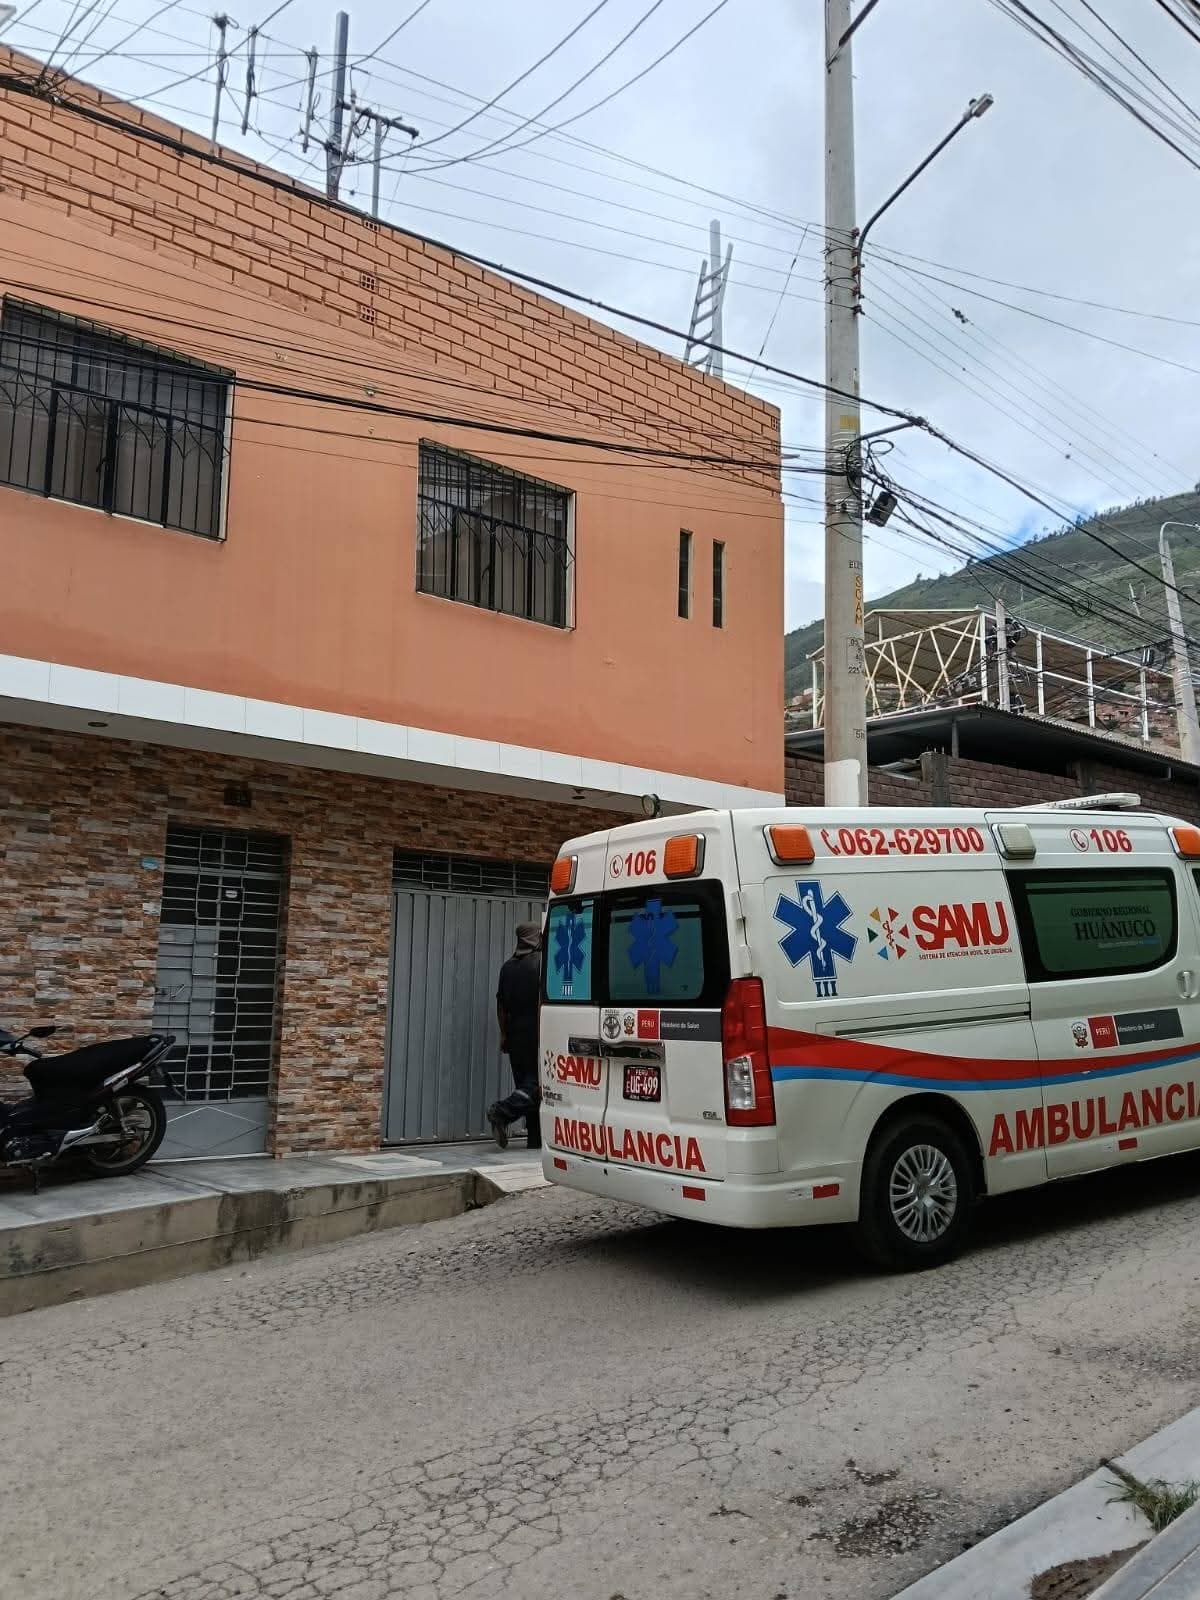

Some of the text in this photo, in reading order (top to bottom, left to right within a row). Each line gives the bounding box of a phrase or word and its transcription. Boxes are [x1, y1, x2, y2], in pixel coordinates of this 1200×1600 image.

[839, 827, 984, 855] 062-629700
[1090, 828, 1132, 853] 106
[625, 850, 656, 877] 106
[912, 901, 1009, 950] SAMU
[556, 1055, 602, 1086] SAMU
[988, 1080, 1200, 1157] AMBULANCI
[554, 1116, 707, 1173] AMBULANCIA
